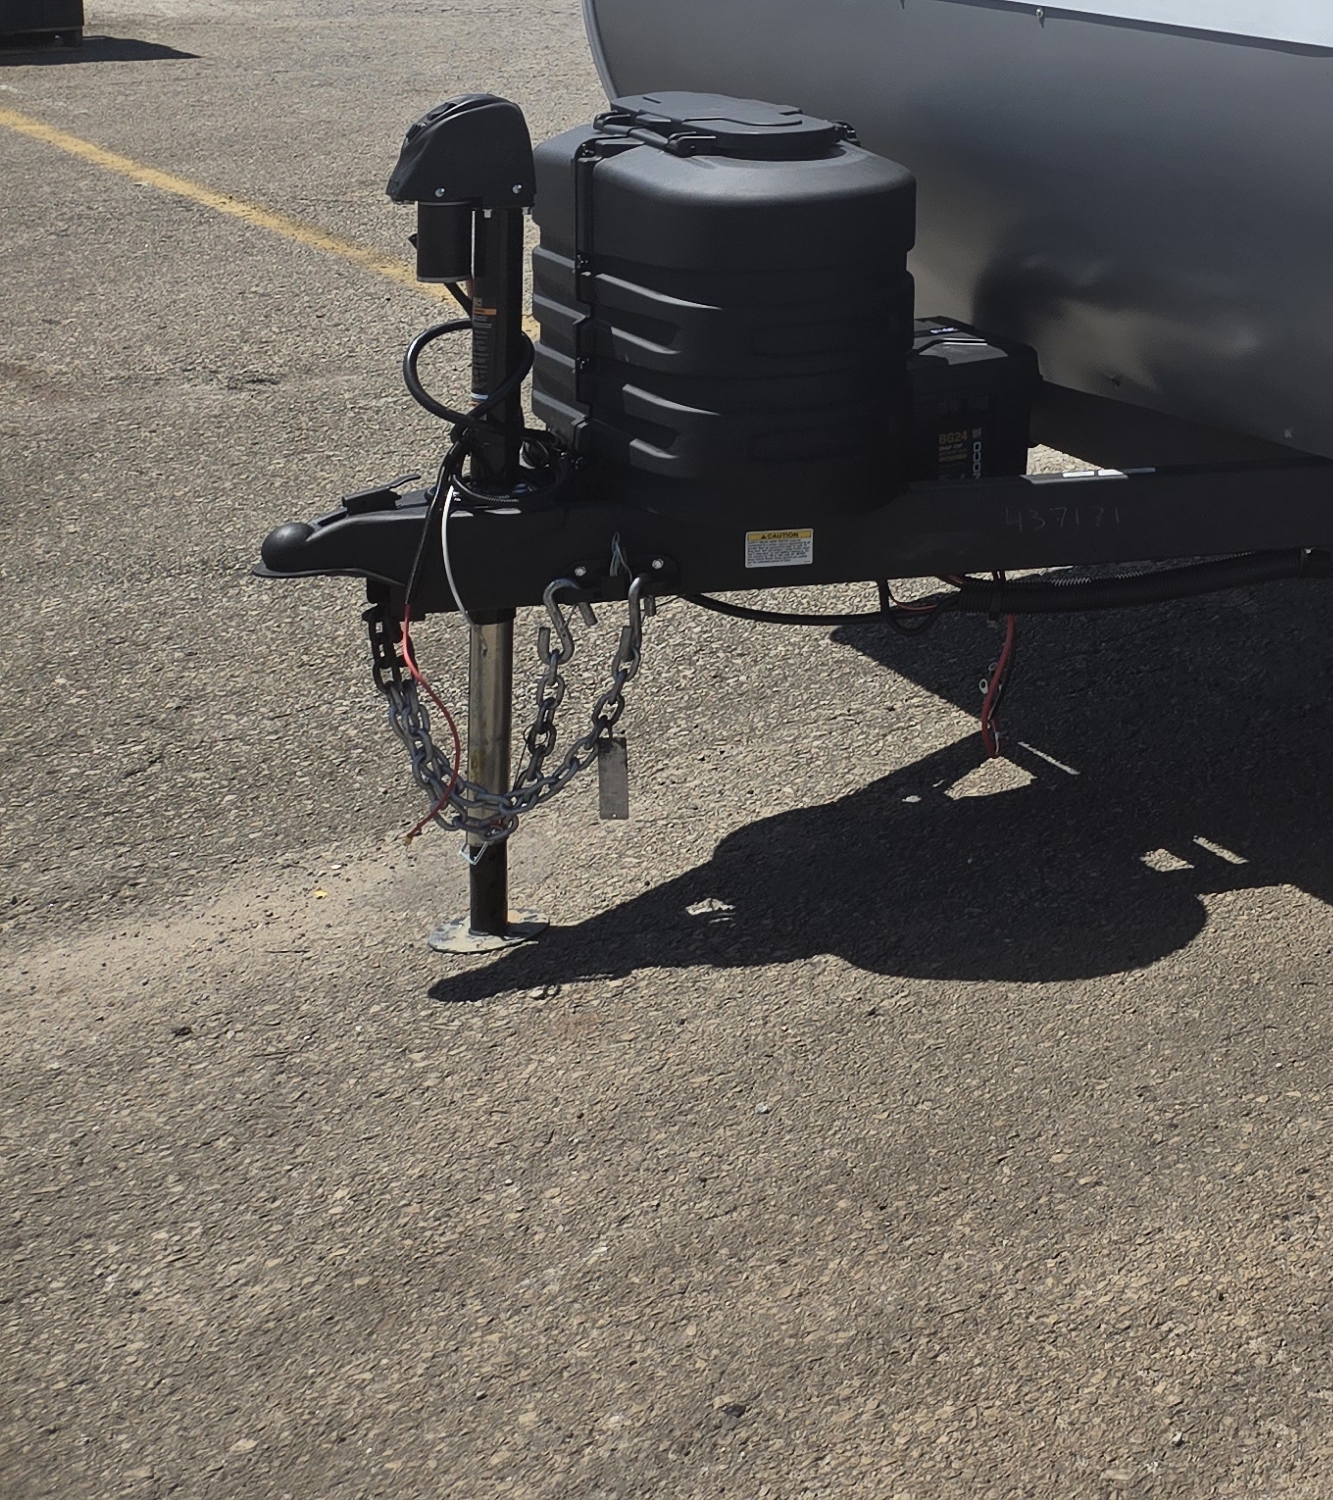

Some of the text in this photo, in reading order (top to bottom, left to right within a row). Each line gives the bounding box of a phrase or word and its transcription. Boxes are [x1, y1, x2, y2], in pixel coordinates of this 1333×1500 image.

[938, 429, 969, 445] BG24
[1004, 504, 1121, 534] 437171
[768, 531, 799, 540] CAUTION
